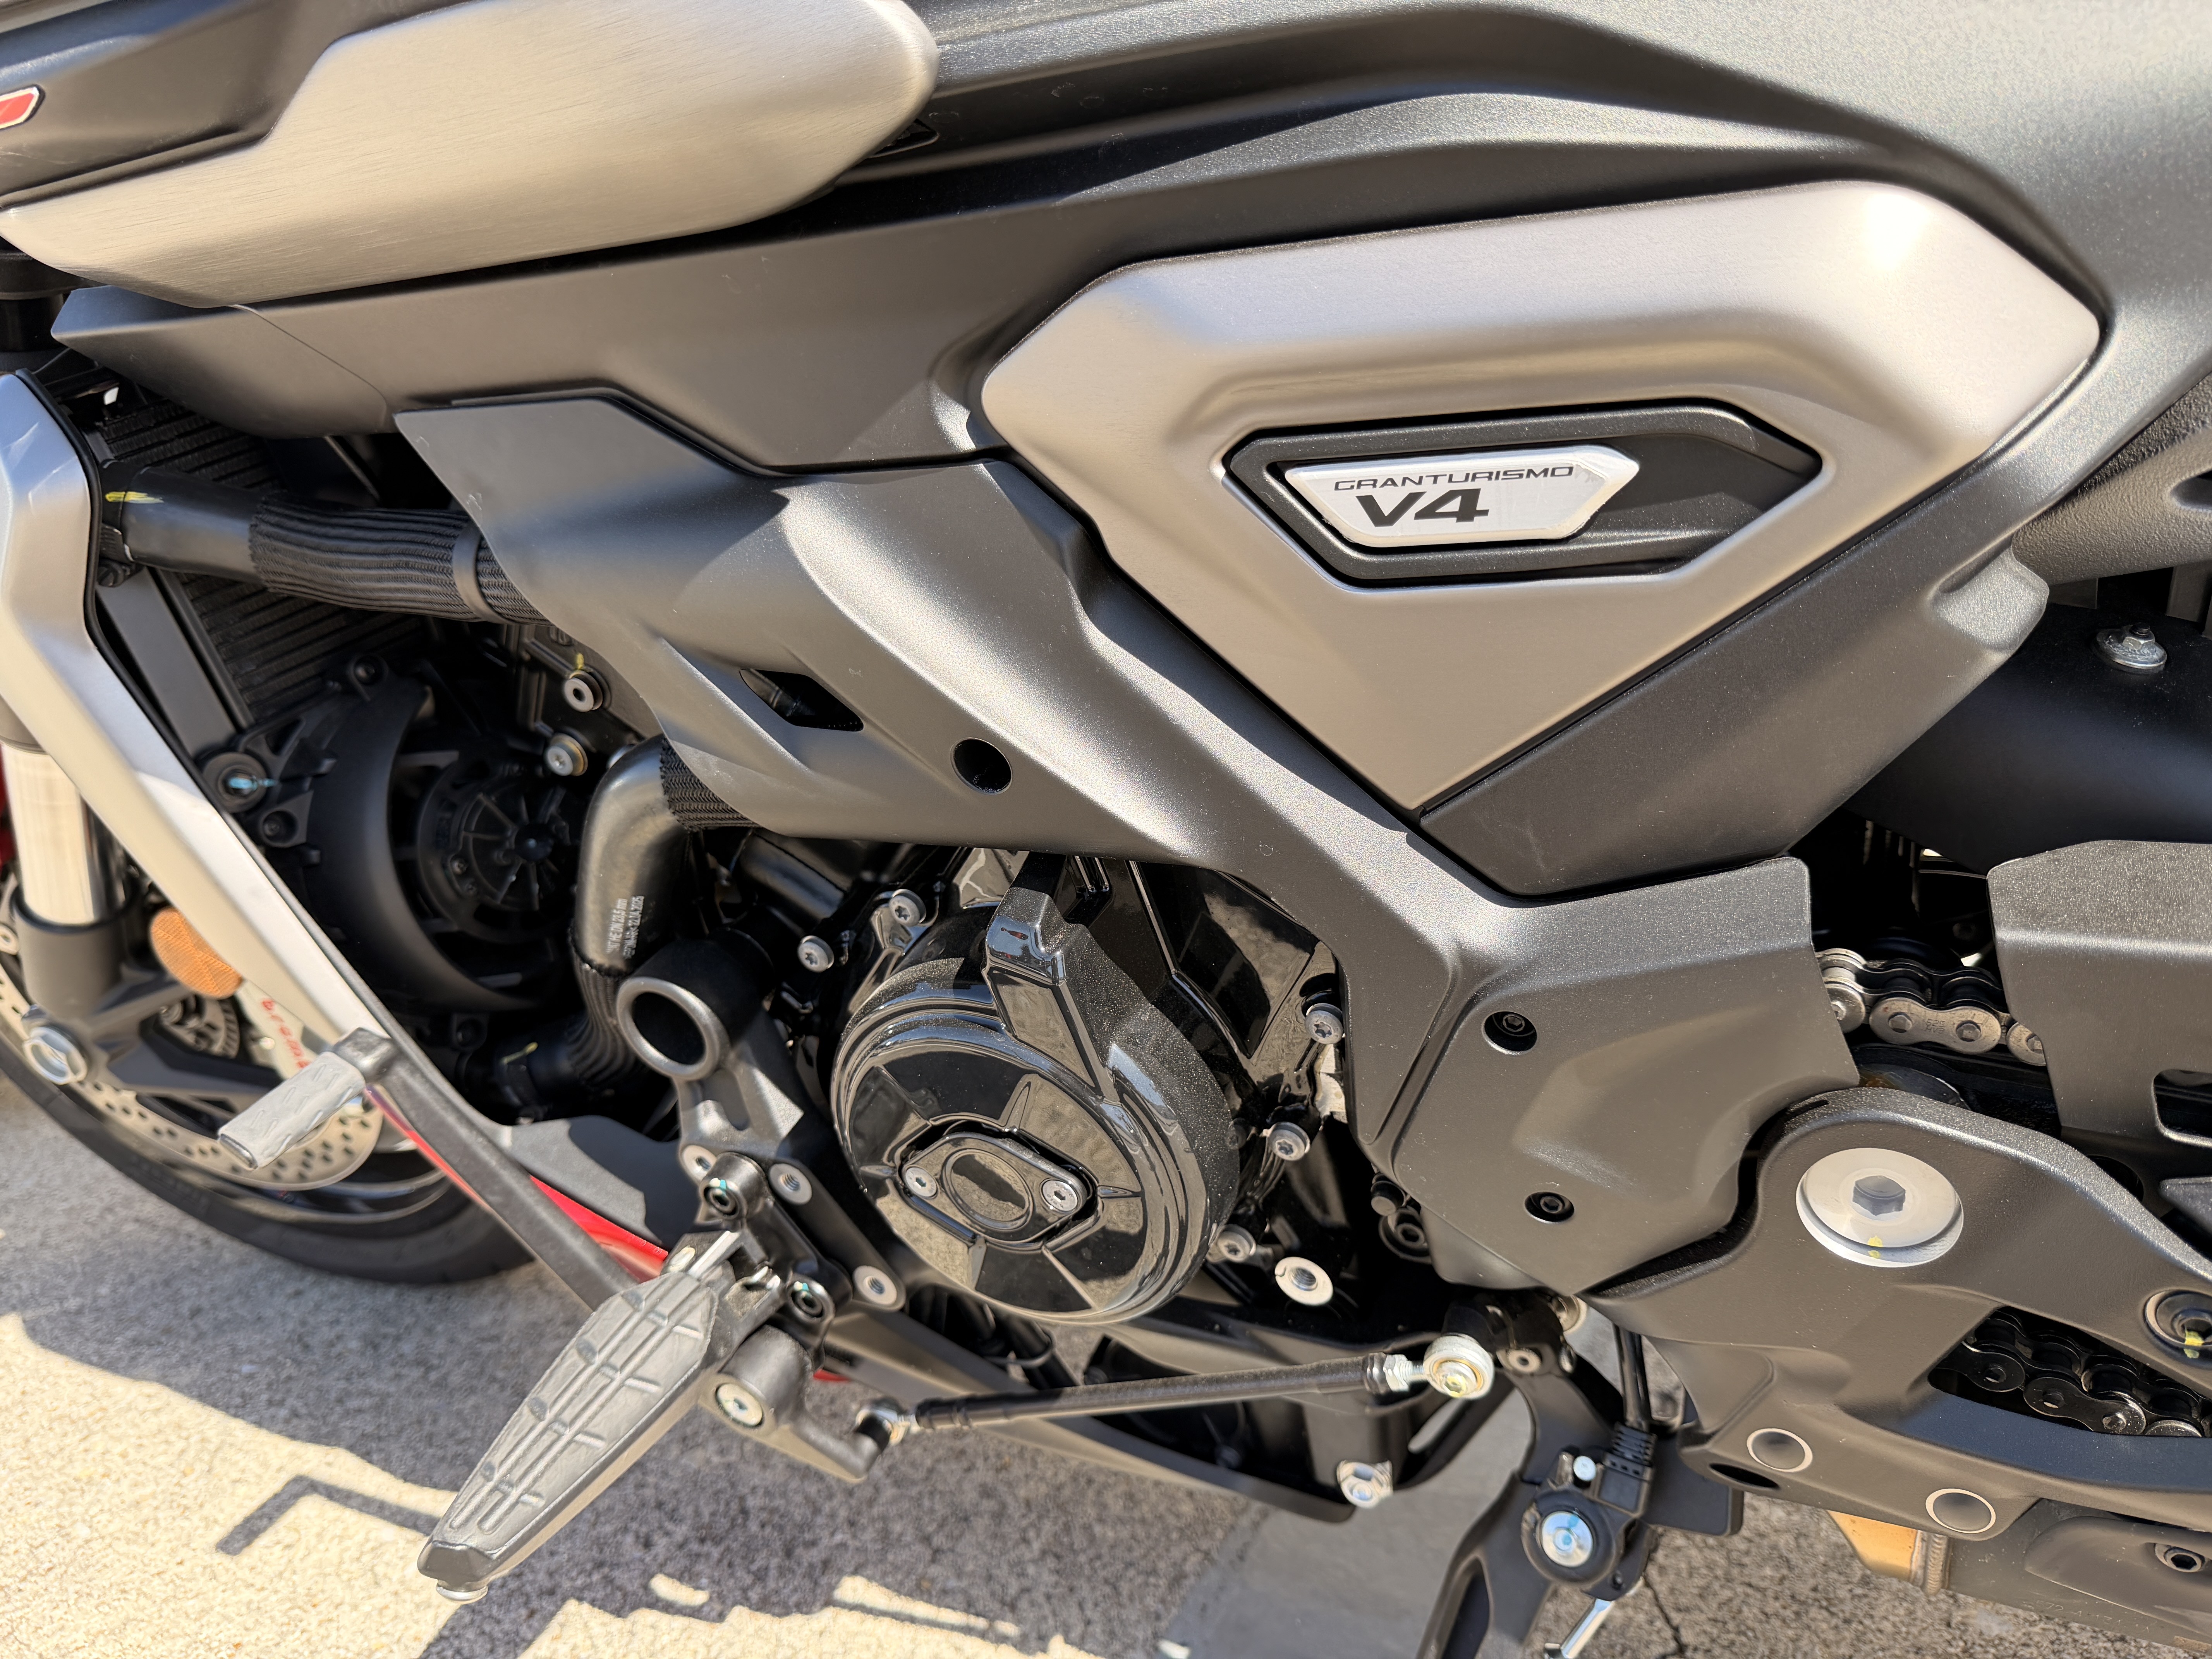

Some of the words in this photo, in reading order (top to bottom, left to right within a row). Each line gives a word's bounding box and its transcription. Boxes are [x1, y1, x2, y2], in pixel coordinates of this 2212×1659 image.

[1334, 466, 1573, 491] GRANTURISMO
[1355, 488, 1489, 527] V4
[1926, 1018, 1945, 1027] 525
